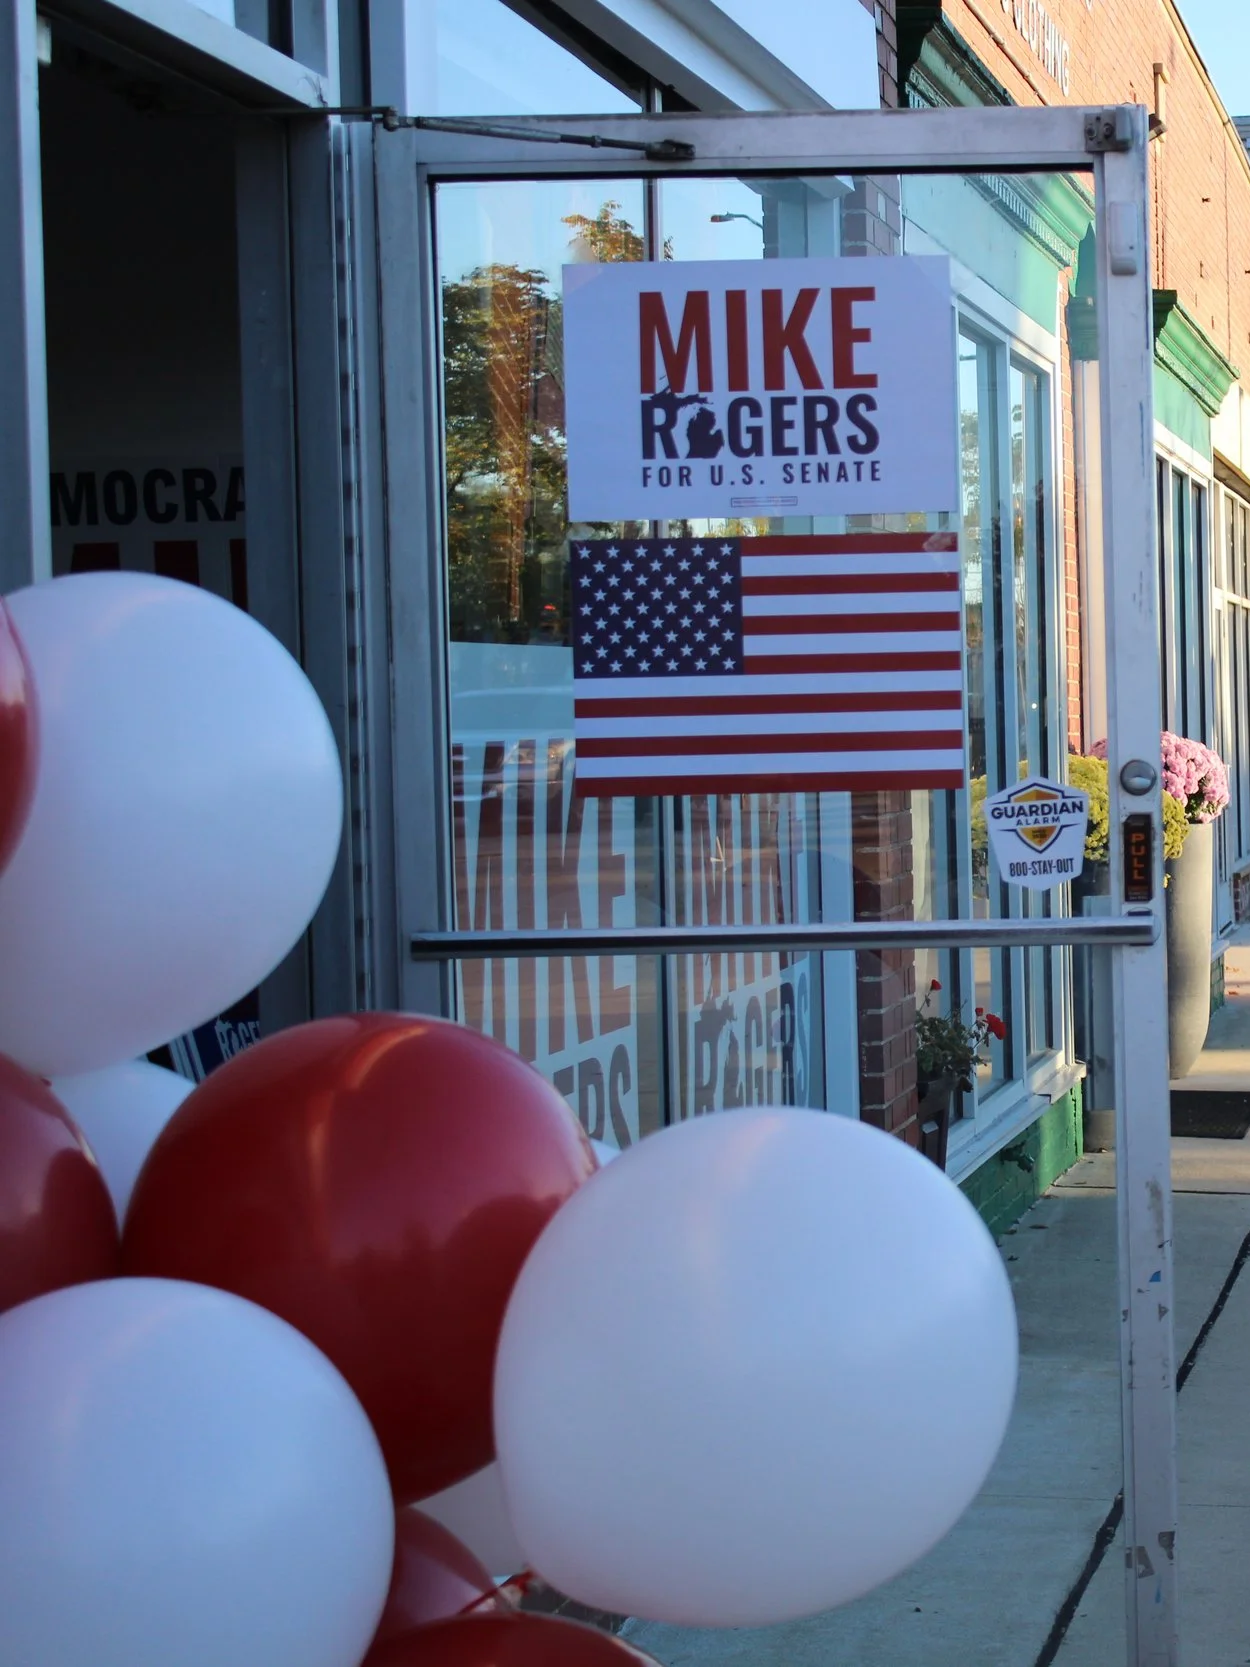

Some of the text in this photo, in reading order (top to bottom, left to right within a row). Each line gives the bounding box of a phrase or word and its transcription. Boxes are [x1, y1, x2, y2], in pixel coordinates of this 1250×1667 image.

[639, 286, 878, 394] MIKE
[642, 460, 881, 488] FOR U.S. SENATE
[991, 801, 1084, 819] GUARDIAN
[1016, 816, 1061, 826] ALARM
[1009, 858, 1075, 877] 800-STAY-OUT
[1131, 833, 1145, 880] PULL
[452, 738, 632, 1064] MIKE
